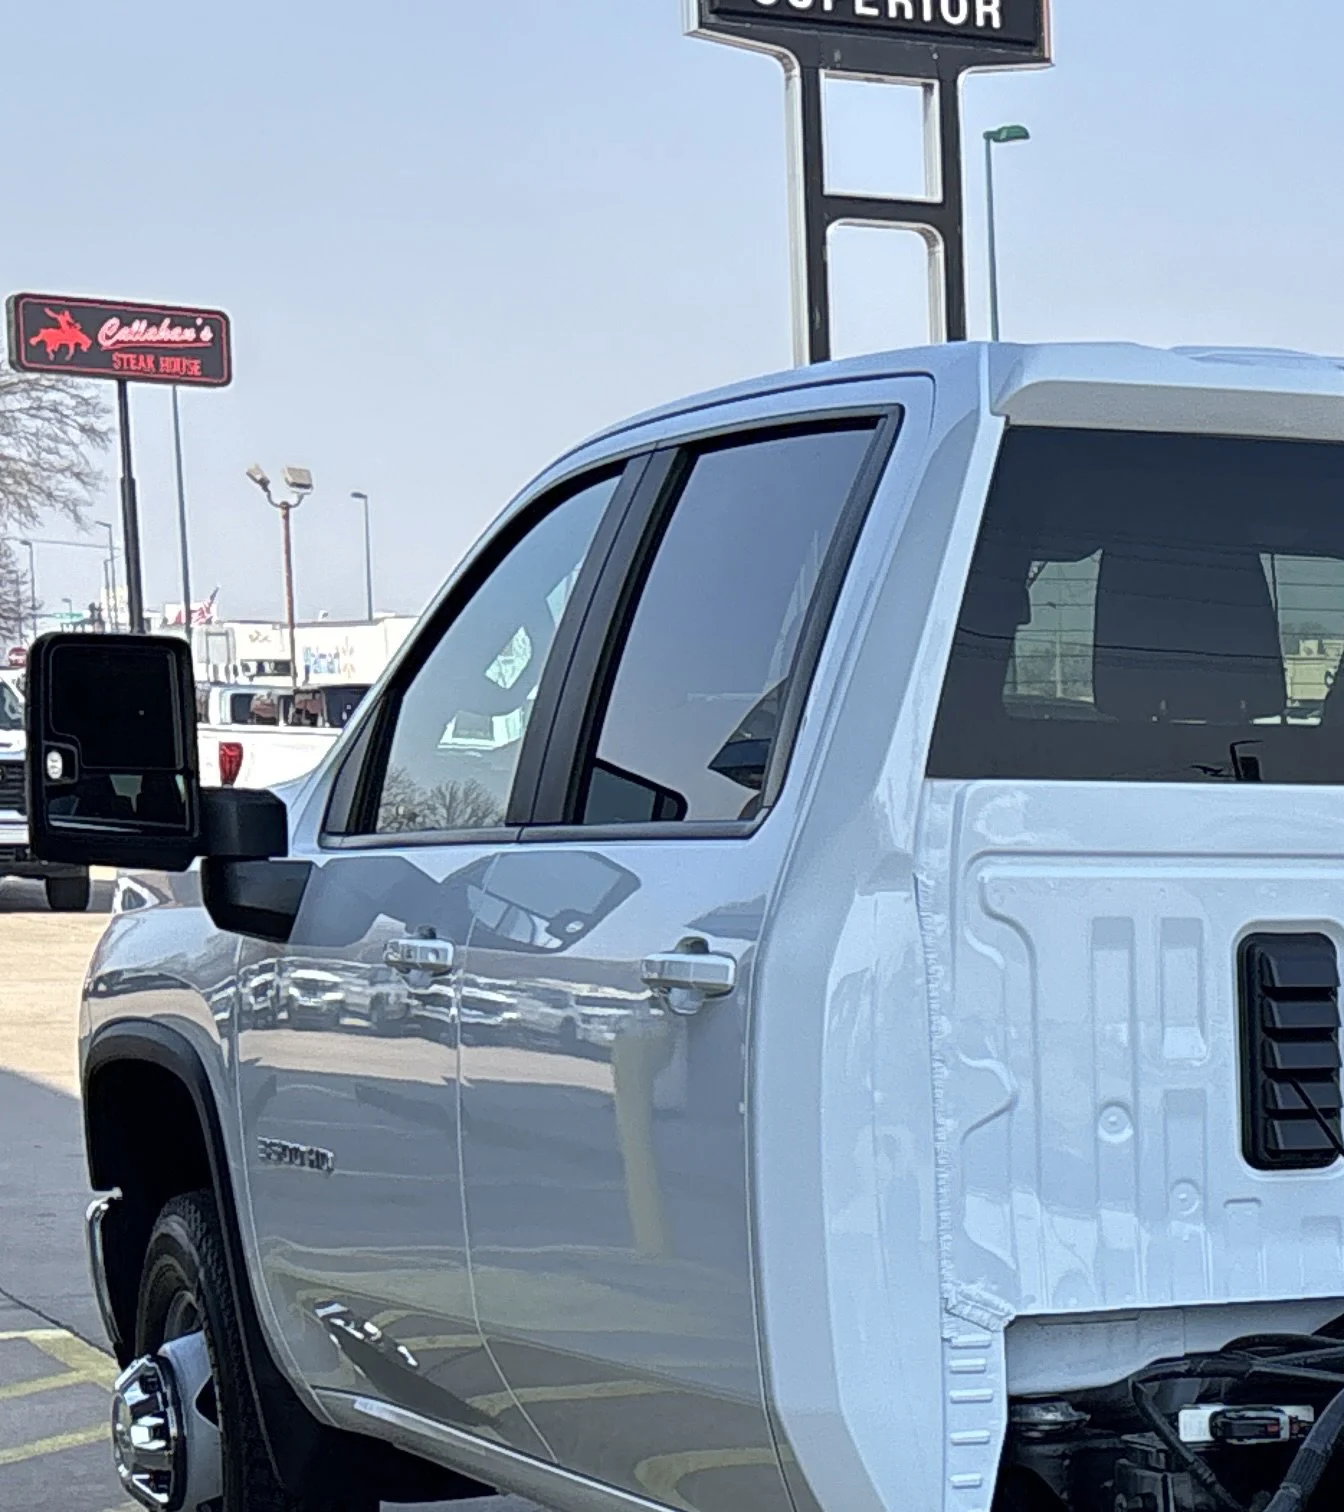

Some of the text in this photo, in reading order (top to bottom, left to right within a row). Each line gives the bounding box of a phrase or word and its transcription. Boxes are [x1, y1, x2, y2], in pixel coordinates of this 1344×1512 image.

[755, 0, 1001, 28] RIOR
[98, 317, 213, 347] Callahan's
[112, 352, 202, 376] STEAK HOUSE
